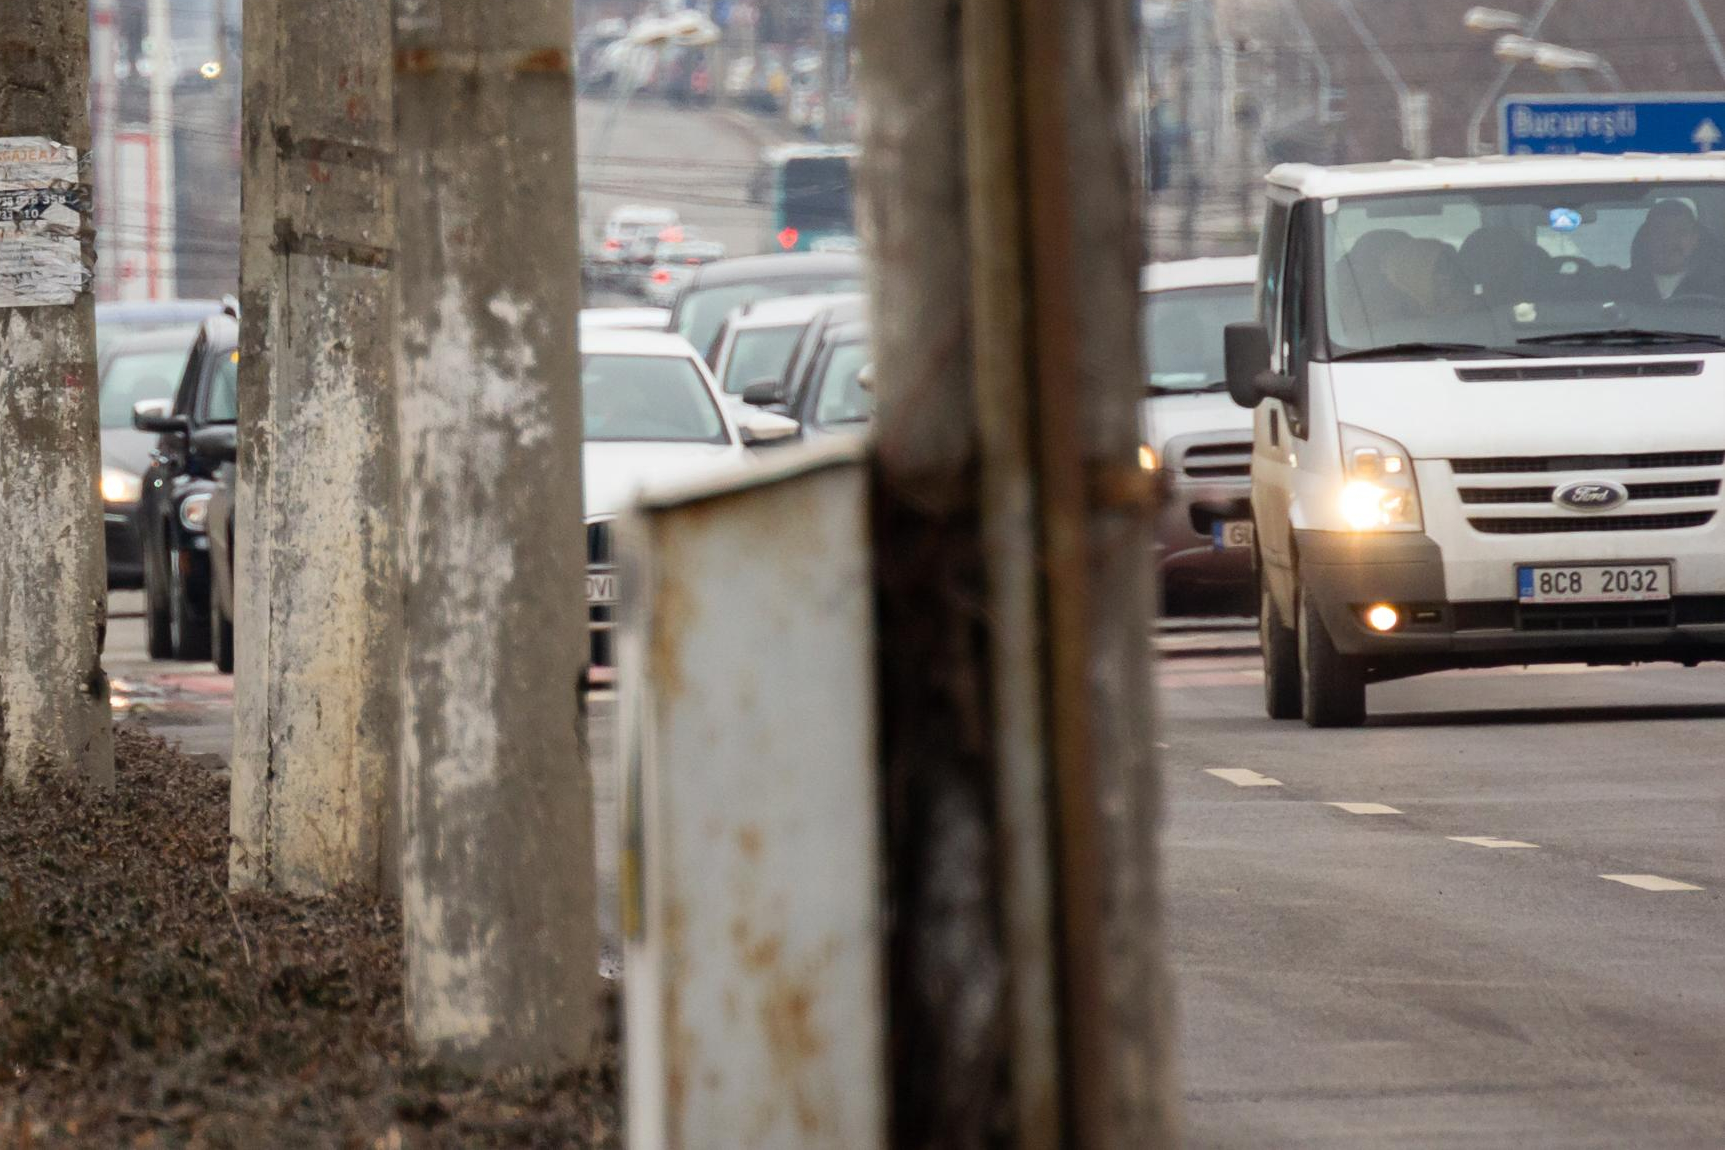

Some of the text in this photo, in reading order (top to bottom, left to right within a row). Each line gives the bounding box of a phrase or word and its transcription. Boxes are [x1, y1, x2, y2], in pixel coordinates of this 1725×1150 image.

[1572, 484, 1609, 503] Ford
[1540, 569, 1658, 594] 8C8 2032
